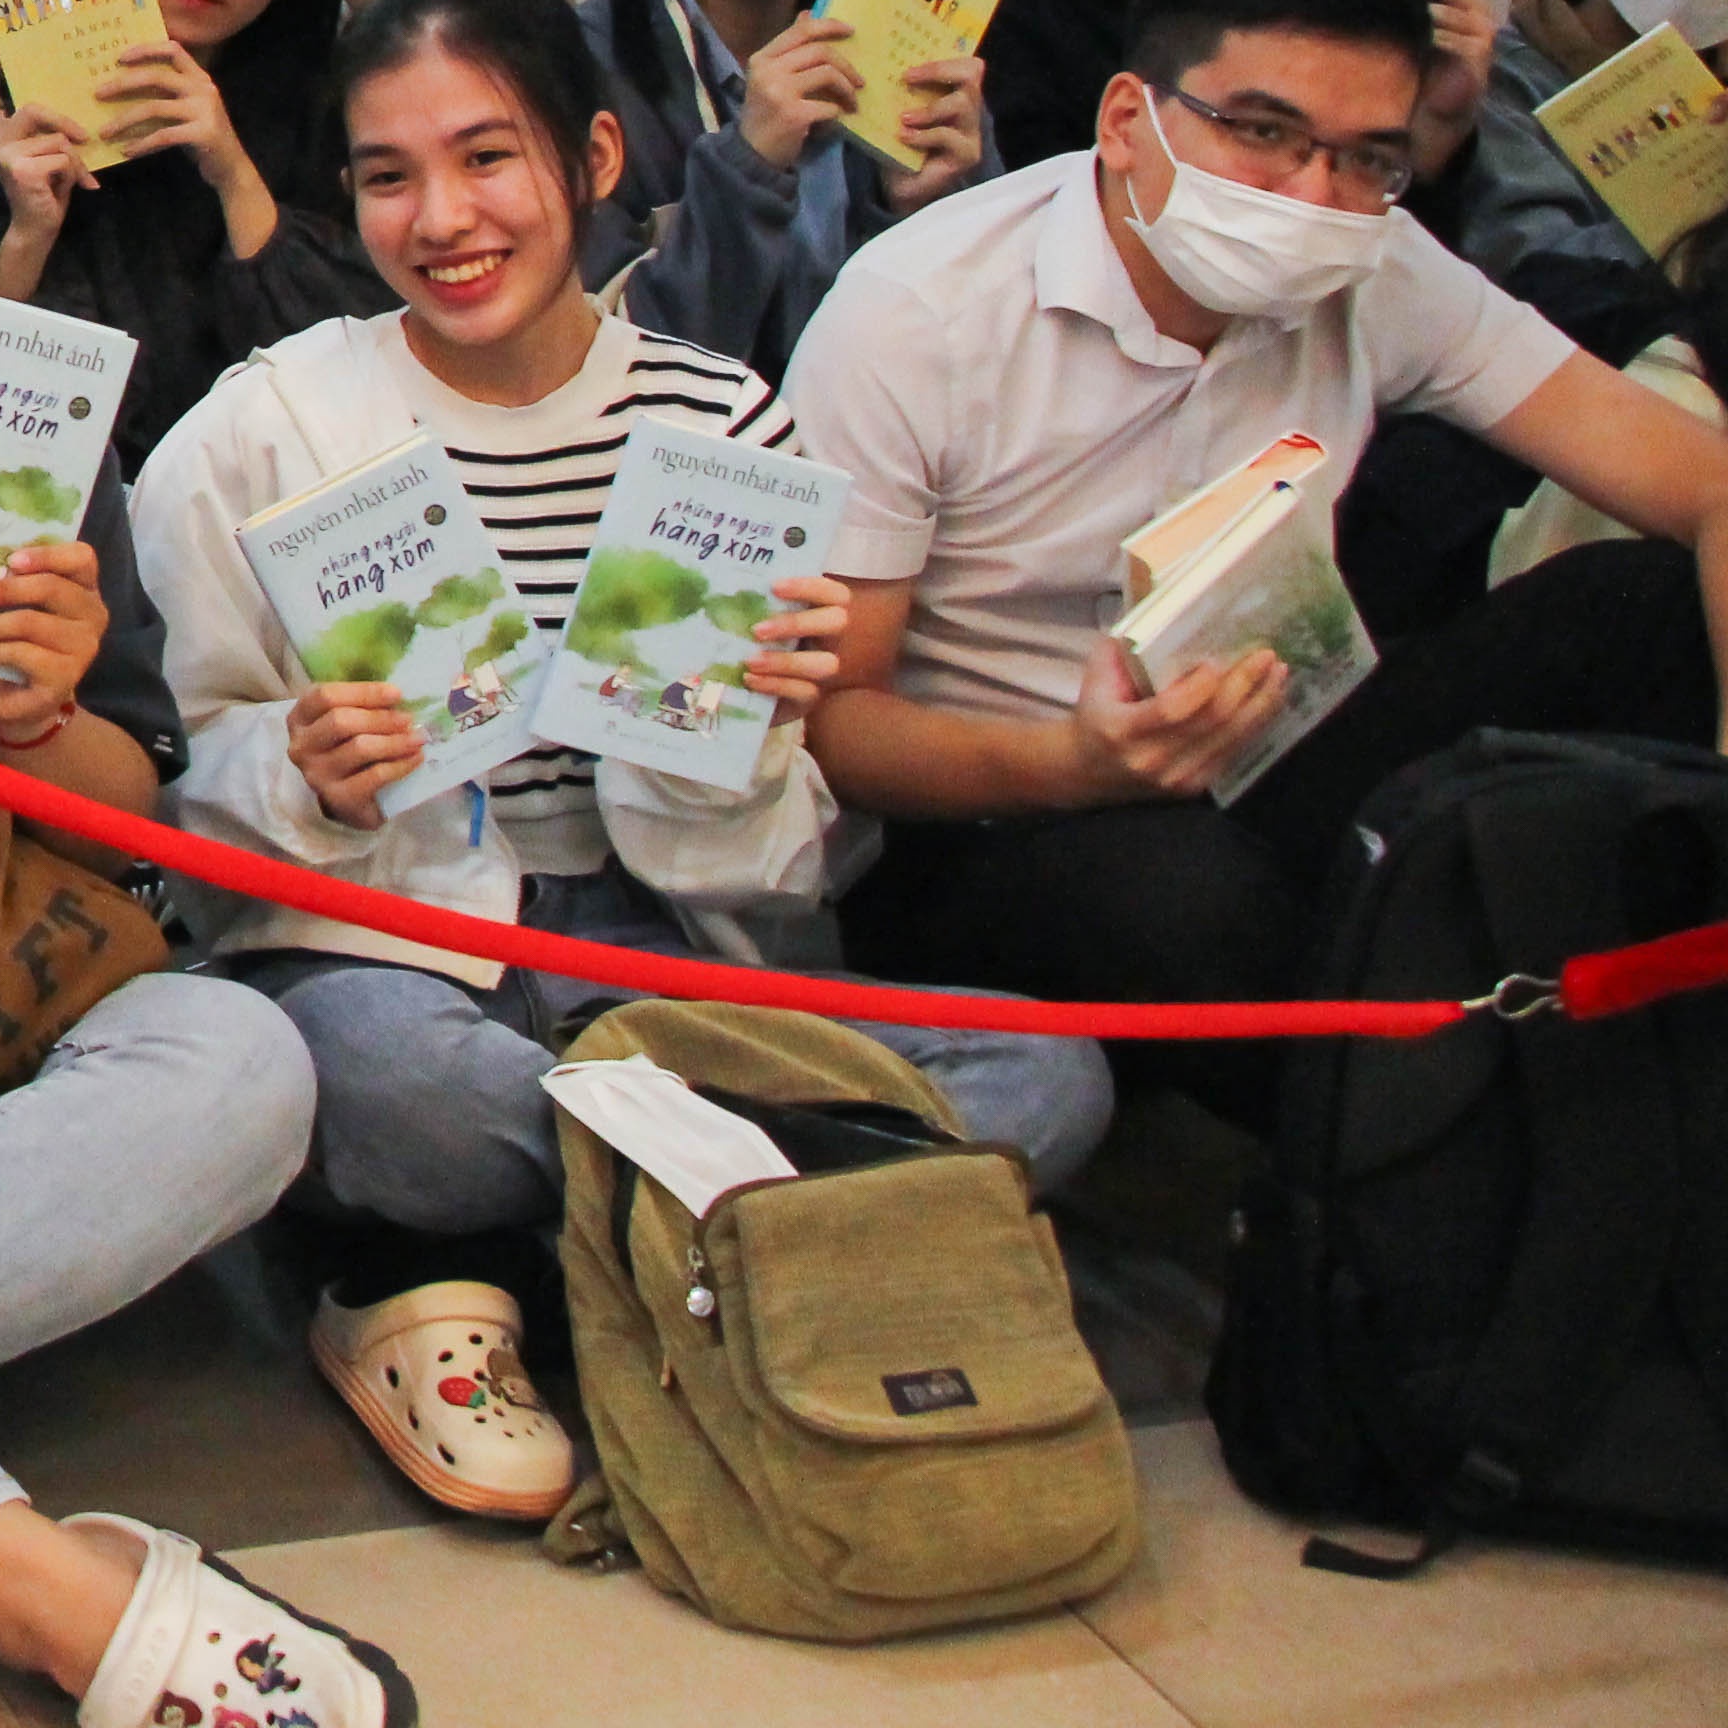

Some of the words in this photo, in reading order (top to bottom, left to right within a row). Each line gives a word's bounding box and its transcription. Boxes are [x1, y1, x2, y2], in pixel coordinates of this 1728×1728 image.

[16, 330, 63, 360] nhật
[65, 346, 105, 375] ánh
[7, 406, 59, 439] xóm
[649, 507, 720, 559] hàng
[723, 536, 774, 565] xóm
[315, 563, 385, 610] hàng
[388, 538, 435, 571] xóm
